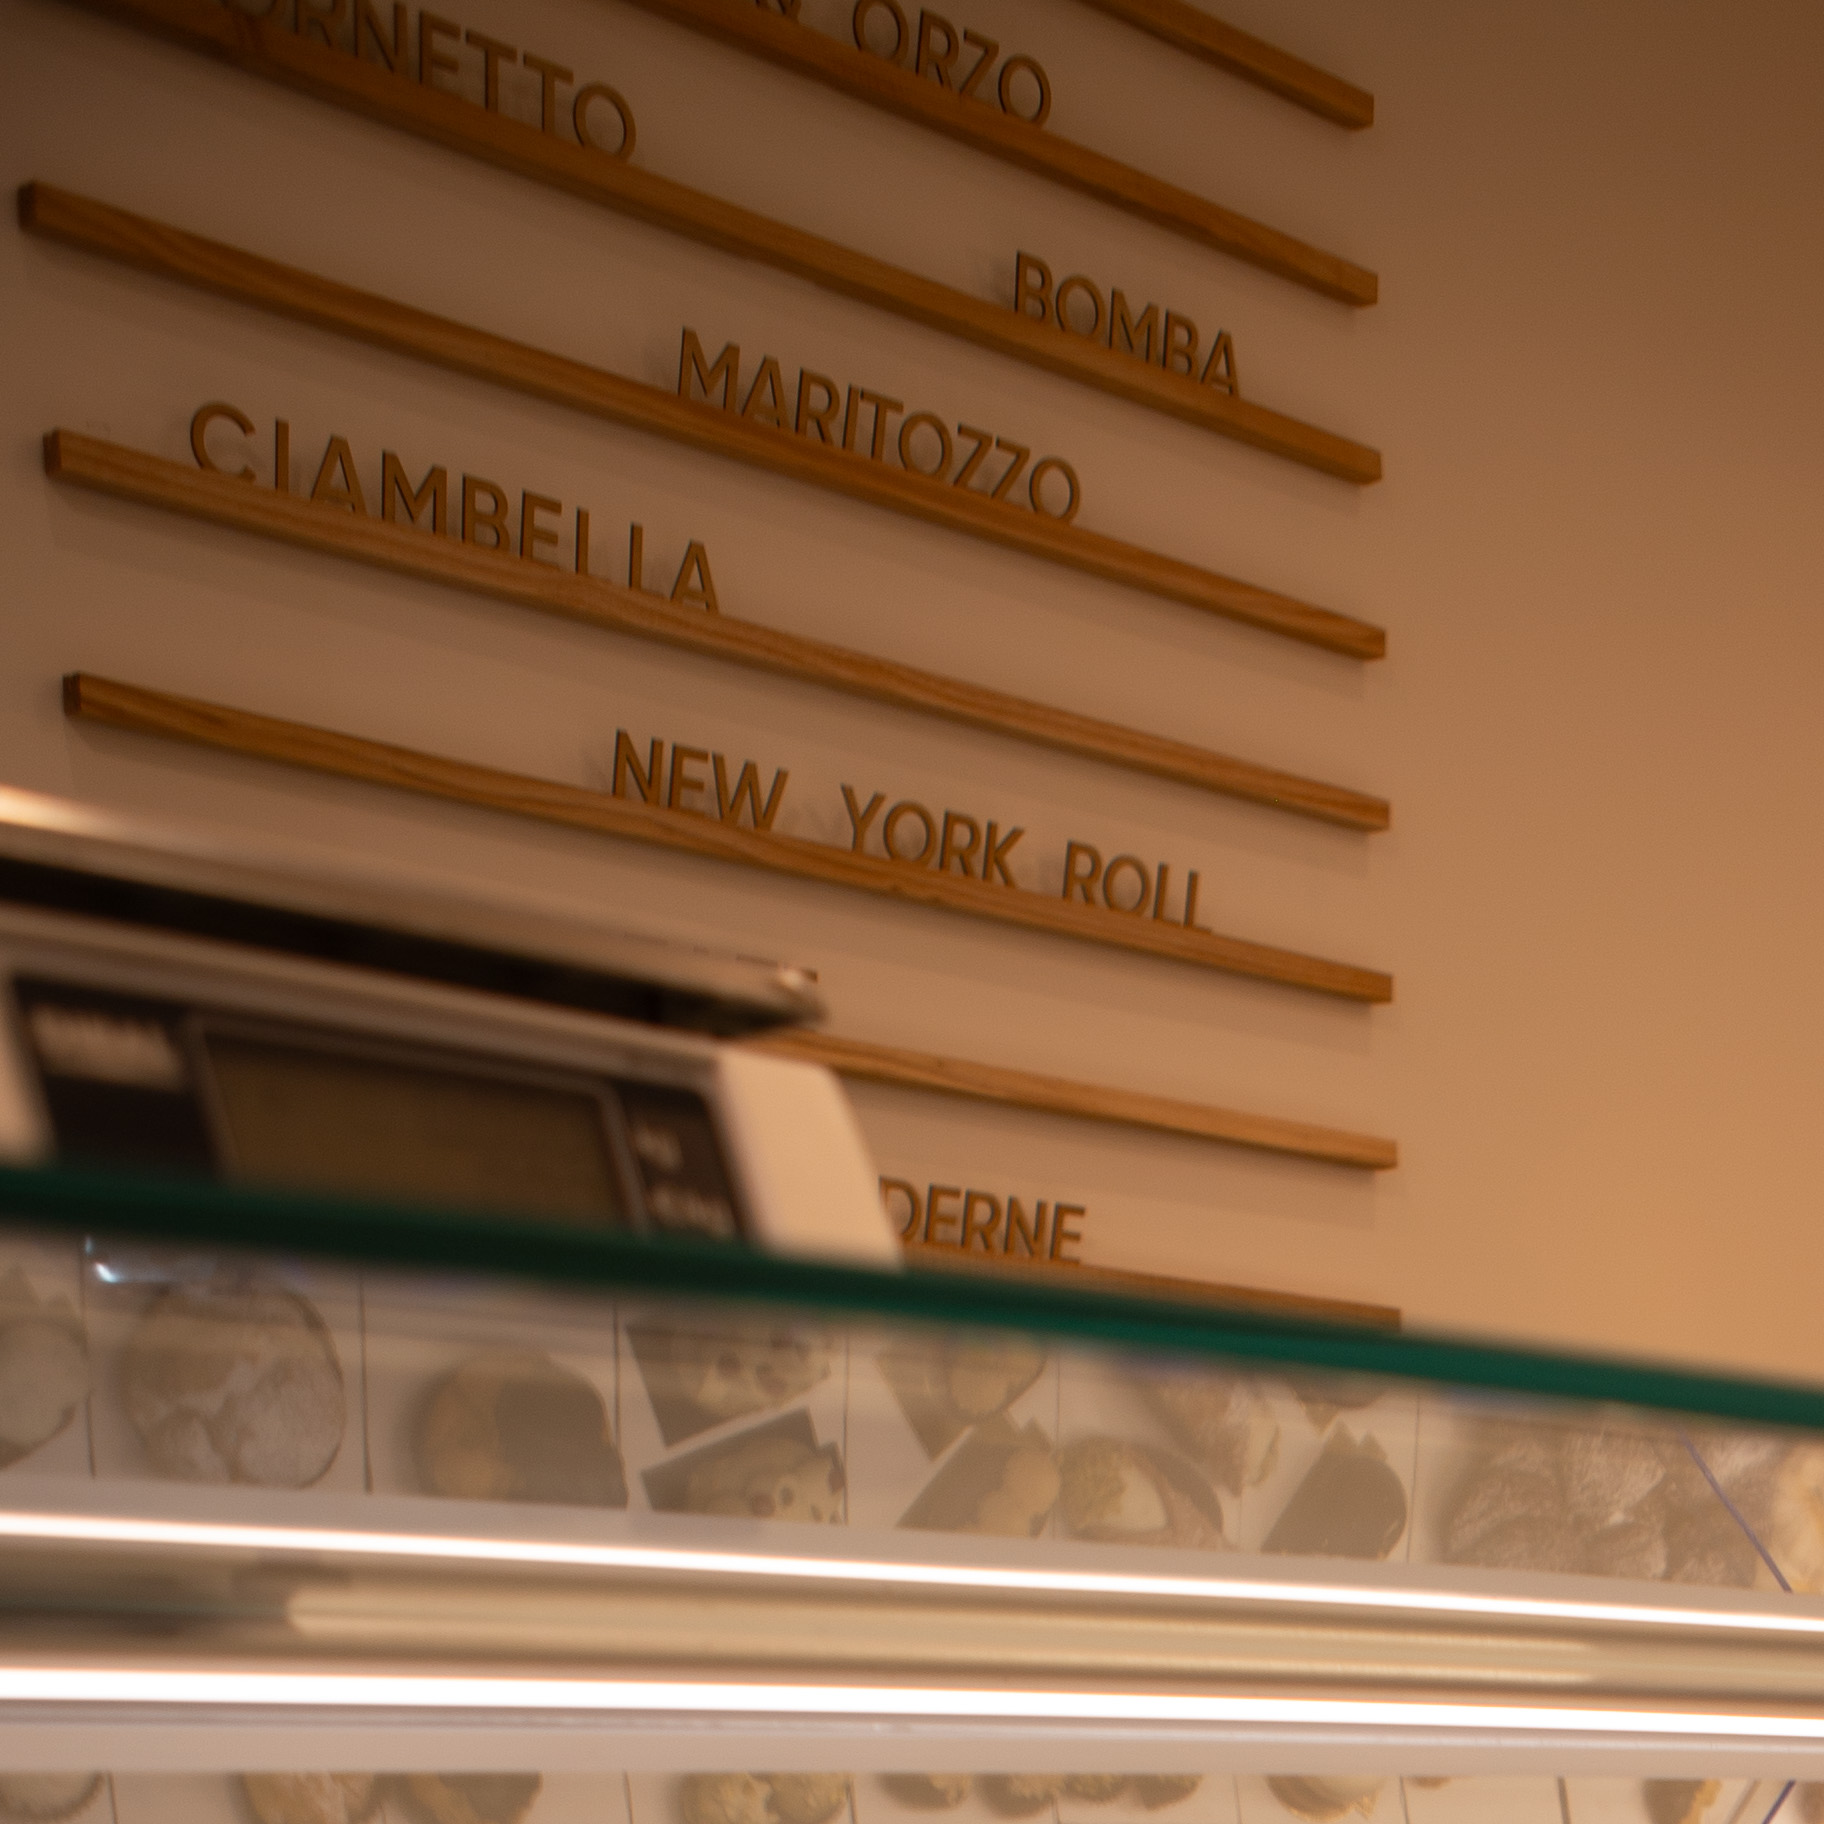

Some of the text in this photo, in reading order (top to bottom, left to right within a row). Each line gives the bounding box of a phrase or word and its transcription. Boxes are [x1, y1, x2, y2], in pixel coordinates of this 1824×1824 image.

[852, 0, 1052, 127] ORZO
[1014, 250, 1242, 398] BOMBA
[190, 401, 719, 613] CIAMBELLA
[677, 325, 1080, 524] MARITOZZO
[611, 728, 1213, 934] NEW YORK ROLL
